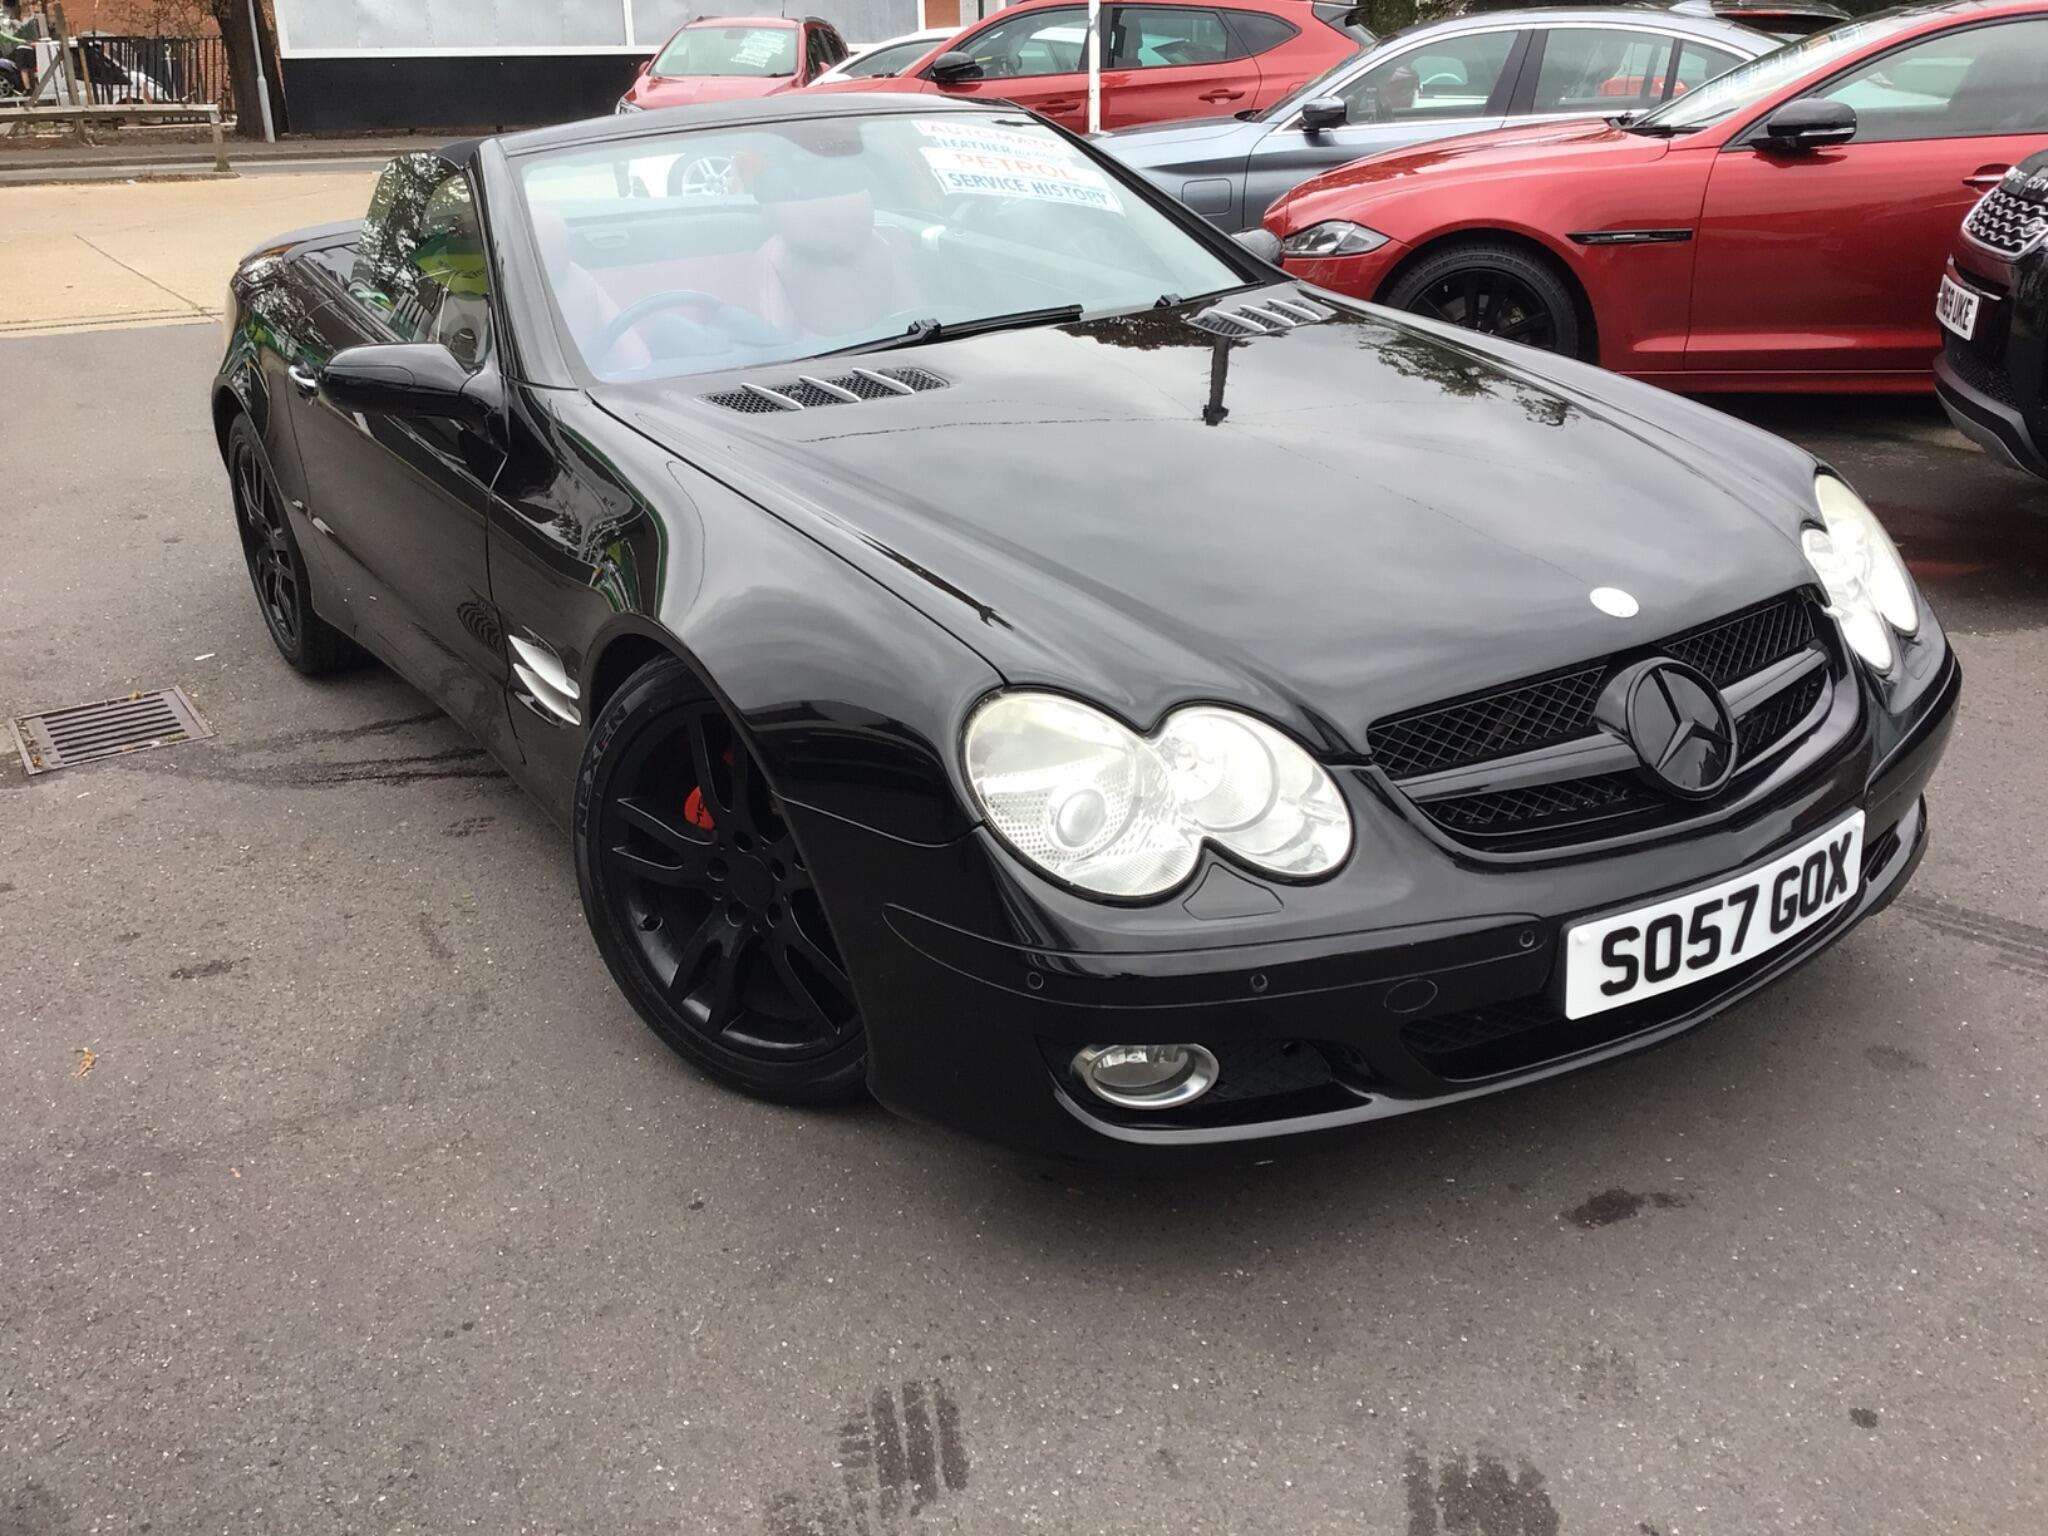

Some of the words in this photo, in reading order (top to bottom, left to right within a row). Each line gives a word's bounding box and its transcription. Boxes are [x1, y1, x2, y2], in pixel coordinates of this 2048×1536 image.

[952, 154, 1074, 181] PETROL
[948, 173, 1028, 193] SERVICE
[1031, 182, 1108, 206] HISTORY
[1600, 884, 1760, 996] SO57
[1770, 831, 1852, 934] GOX
